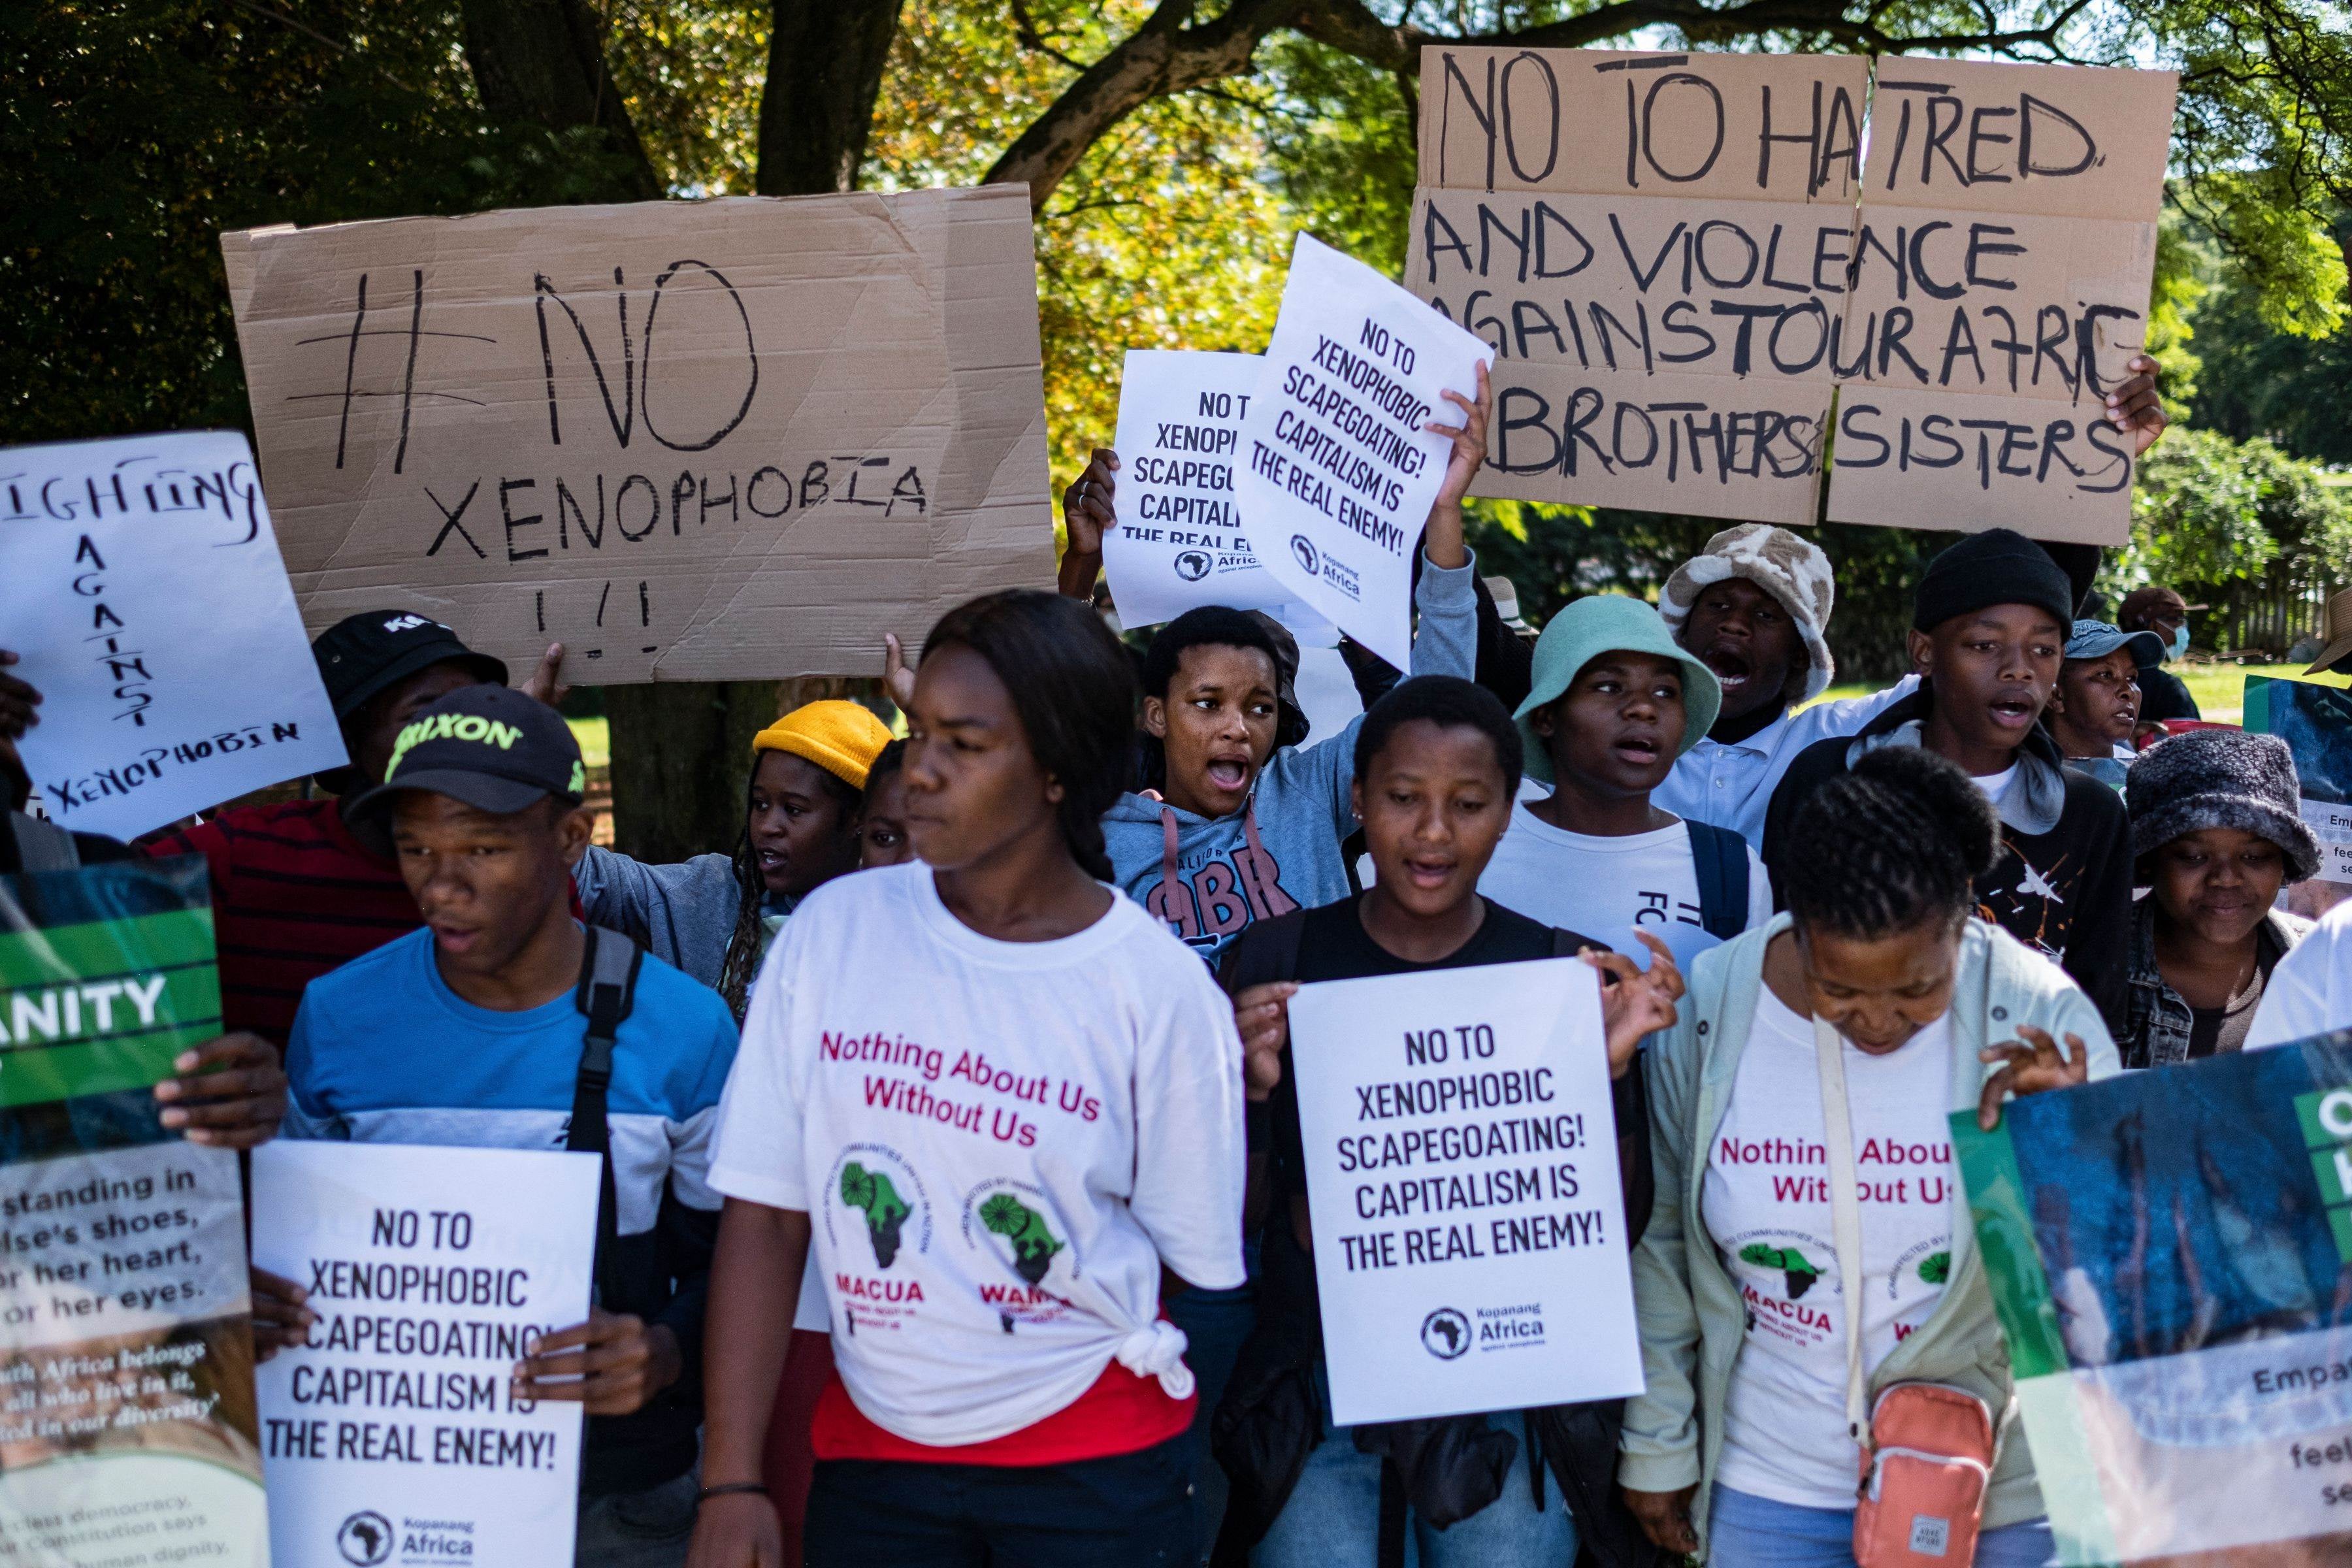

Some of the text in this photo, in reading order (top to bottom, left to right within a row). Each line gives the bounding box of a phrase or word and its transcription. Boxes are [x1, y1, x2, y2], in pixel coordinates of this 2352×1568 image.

[1441, 51, 1560, 193] NO
[1593, 56, 1724, 189] TO
[1424, 199, 2028, 301] AND VIOLENCE
[1360, 318, 1415, 376] NO TO
[1198, 391, 1252, 421] NO T
[1311, 334, 1431, 433] XENOPHOBIC
[1155, 423, 1238, 455] XENOP
[1283, 365, 1426, 480] SCAPEGOATING!
[1275, 410, 1404, 512] CAPITALISM IS
[1835, 404, 2130, 494] SISTERS
[423, 455, 927, 566] XENOPHOBIA
[1250, 440, 1403, 557] THE REAL ENEMY!
[1122, 526, 1164, 542] THE
[1169, 531, 1228, 549] REAL
[1218, 557, 1259, 567] Afric
[1323, 564, 1360, 596] Africa
[0, 973, 167, 1046] NITY
[1403, 1023, 1495, 1067] NO TO
[820, 1030, 1102, 1122] Nothing About Us
[1356, 1068, 1556, 1121] XENOPHOBIC
[864, 1074, 1037, 1148] Without Us
[1337, 1114, 1586, 1173] SCAPEGOATING!
[1720, 1137, 1951, 1165] Nothin Abou
[3, 1167, 196, 1218] standing in
[1355, 1164, 1578, 1219] CAPITALISM IS
[1772, 1176, 1908, 1203] Witout
[91, 1207, 198, 1240] shoes,
[371, 1208, 472, 1250] NO TO
[1339, 1210, 1605, 1273] THE REAL ENEMY!
[35, 1260, 90, 1286] her
[103, 1241, 201, 1274] heart,
[308, 1258, 529, 1307] XENOPHOBIC
[4, 1281, 204, 1325] or her eyes.
[1743, 1283, 1833, 1334] MACUA
[284, 1313, 553, 1360] CAPEGOATING
[1480, 1318, 1543, 1341] Africa
[291, 1365, 496, 1413] CAPITALISM
[2253, 1359, 2352, 1394] Empa
[266, 1419, 557, 1471] THE REAL ENEMY!
[402, 1533, 473, 1555] Africa
